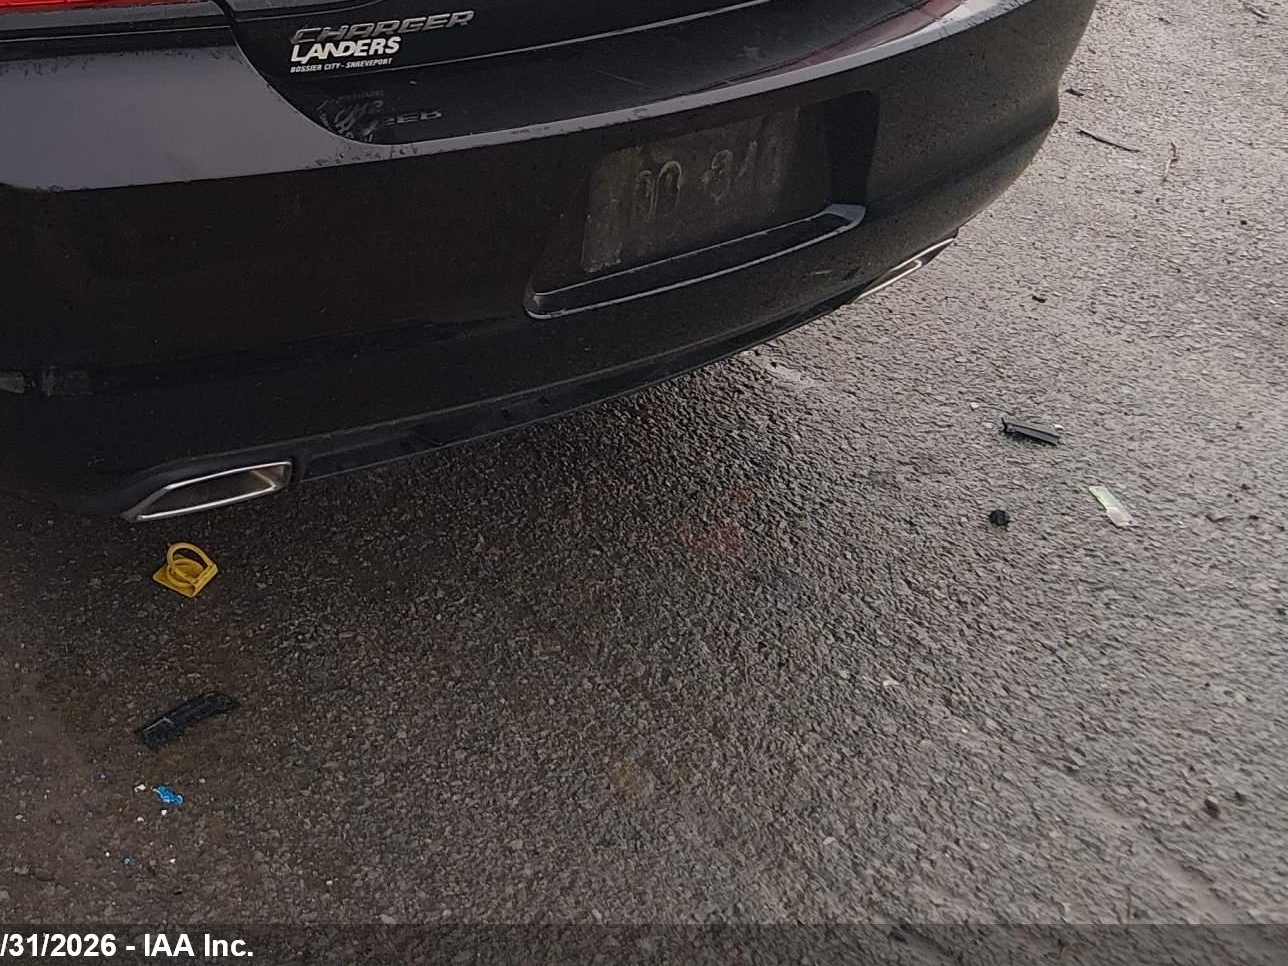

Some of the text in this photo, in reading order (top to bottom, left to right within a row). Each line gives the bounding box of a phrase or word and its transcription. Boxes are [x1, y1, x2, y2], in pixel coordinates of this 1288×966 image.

[290, 10, 475, 45] CHARGER
[290, 36, 402, 64] LANDERS
[290, 64, 322, 73] BOSSIER
[324, 62, 341, 70] CITY
[345, 57, 393, 69] SHREVEPORT
